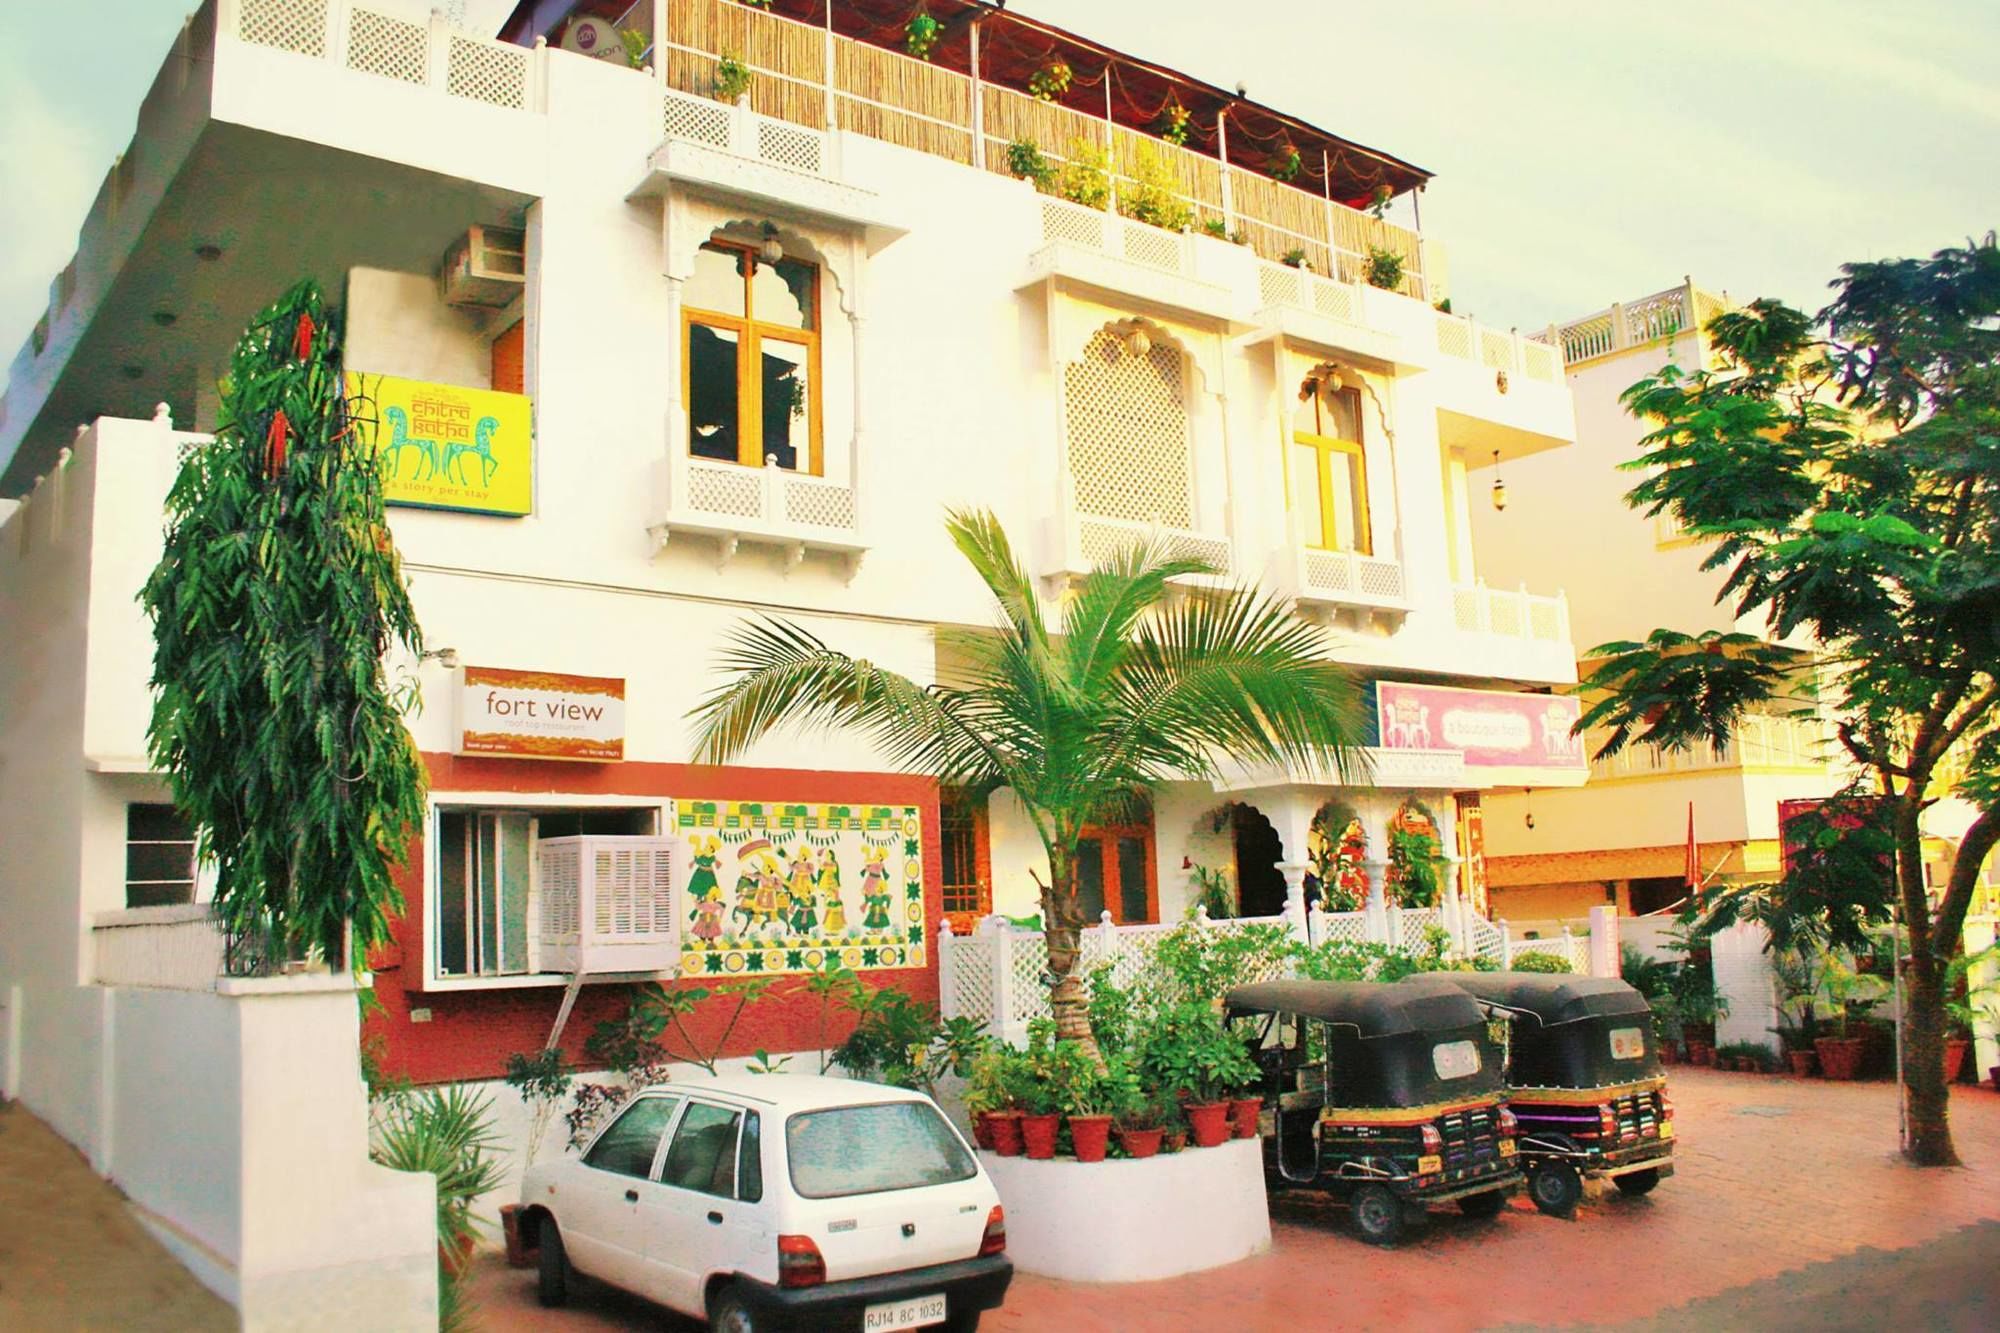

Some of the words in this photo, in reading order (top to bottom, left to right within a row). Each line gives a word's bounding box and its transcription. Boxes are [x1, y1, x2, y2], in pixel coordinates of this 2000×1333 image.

[403, 482, 433, 494] story
[439, 487, 459, 496] per
[464, 489, 489, 500] stay
[486, 691, 536, 717] fort
[546, 699, 604, 721] view
[866, 1311, 894, 1328] RJ14
[919, 1302, 944, 1320] 1032
